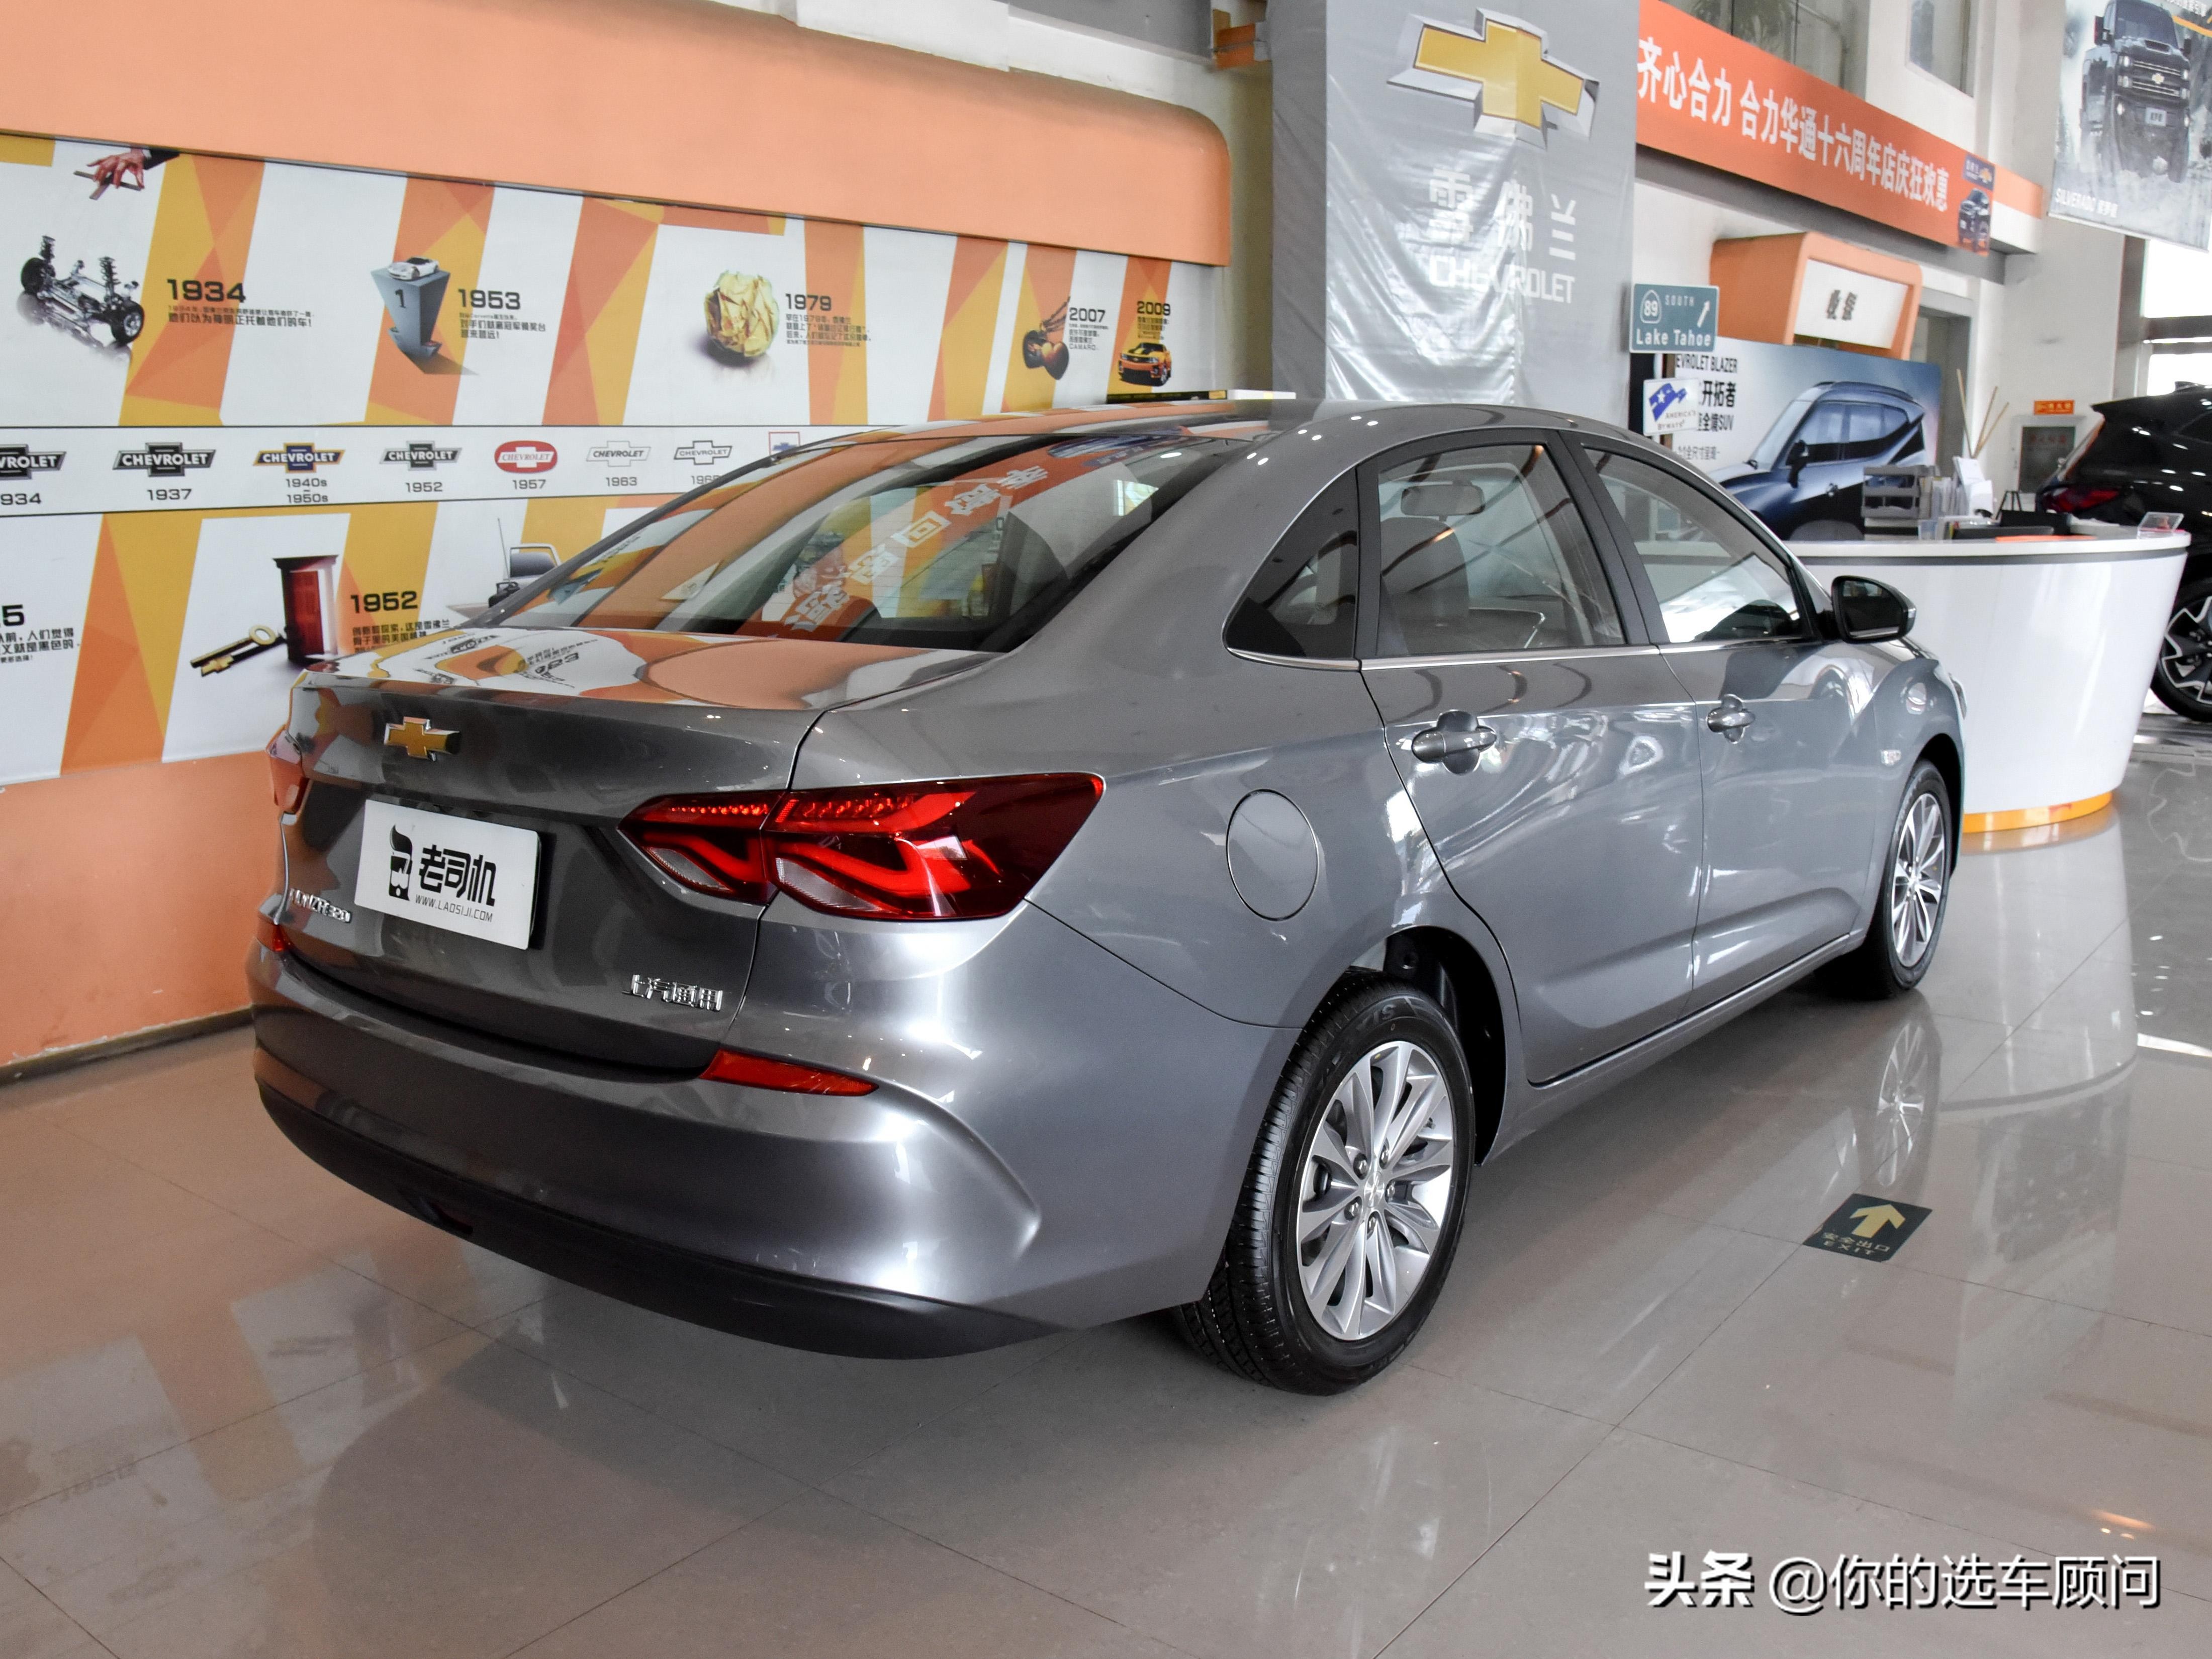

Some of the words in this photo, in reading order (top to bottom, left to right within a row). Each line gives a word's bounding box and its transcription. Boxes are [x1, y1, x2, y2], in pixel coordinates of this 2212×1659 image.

[1636, 36, 1733, 127] 齐心合力
[167, 279, 246, 303] 1934
[458, 289, 520, 310] 1953
[785, 294, 832, 311] 1979
[1664, 294, 1695, 307] SOUTH
[1069, 307, 1105, 322] 2007
[1137, 301, 1170, 316] 2009
[1643, 300, 1659, 317] 89
[1635, 328, 1669, 346] Lake
[1673, 328, 1712, 347] Tahoe
[1711, 356, 1738, 373] BLAZER
[1699, 380, 1736, 408] 开拓者
[122, 453, 208, 466] CHEVROLET
[262, 452, 336, 463] CHEVROLET
[388, 450, 454, 461] CHEVROLET
[501, 451, 552, 462] CHEVROLET
[593, 449, 644, 458] CHEVROLET
[285, 478, 328, 488] 1940s
[405, 482, 443, 493] 1952
[512, 479, 546, 490] 1957
[605, 476, 638, 487] 1963
[147, 488, 192, 501] 1937
[287, 493, 329, 504] 1950s
[350, 590, 418, 614] 1952
[0, 604, 25, 627] 5
[419, 844, 496, 906] 老司机
[415, 894, 493, 923] WWW.LAOSIJI.COM
[1823, 1240, 1875, 1255] EXIT
